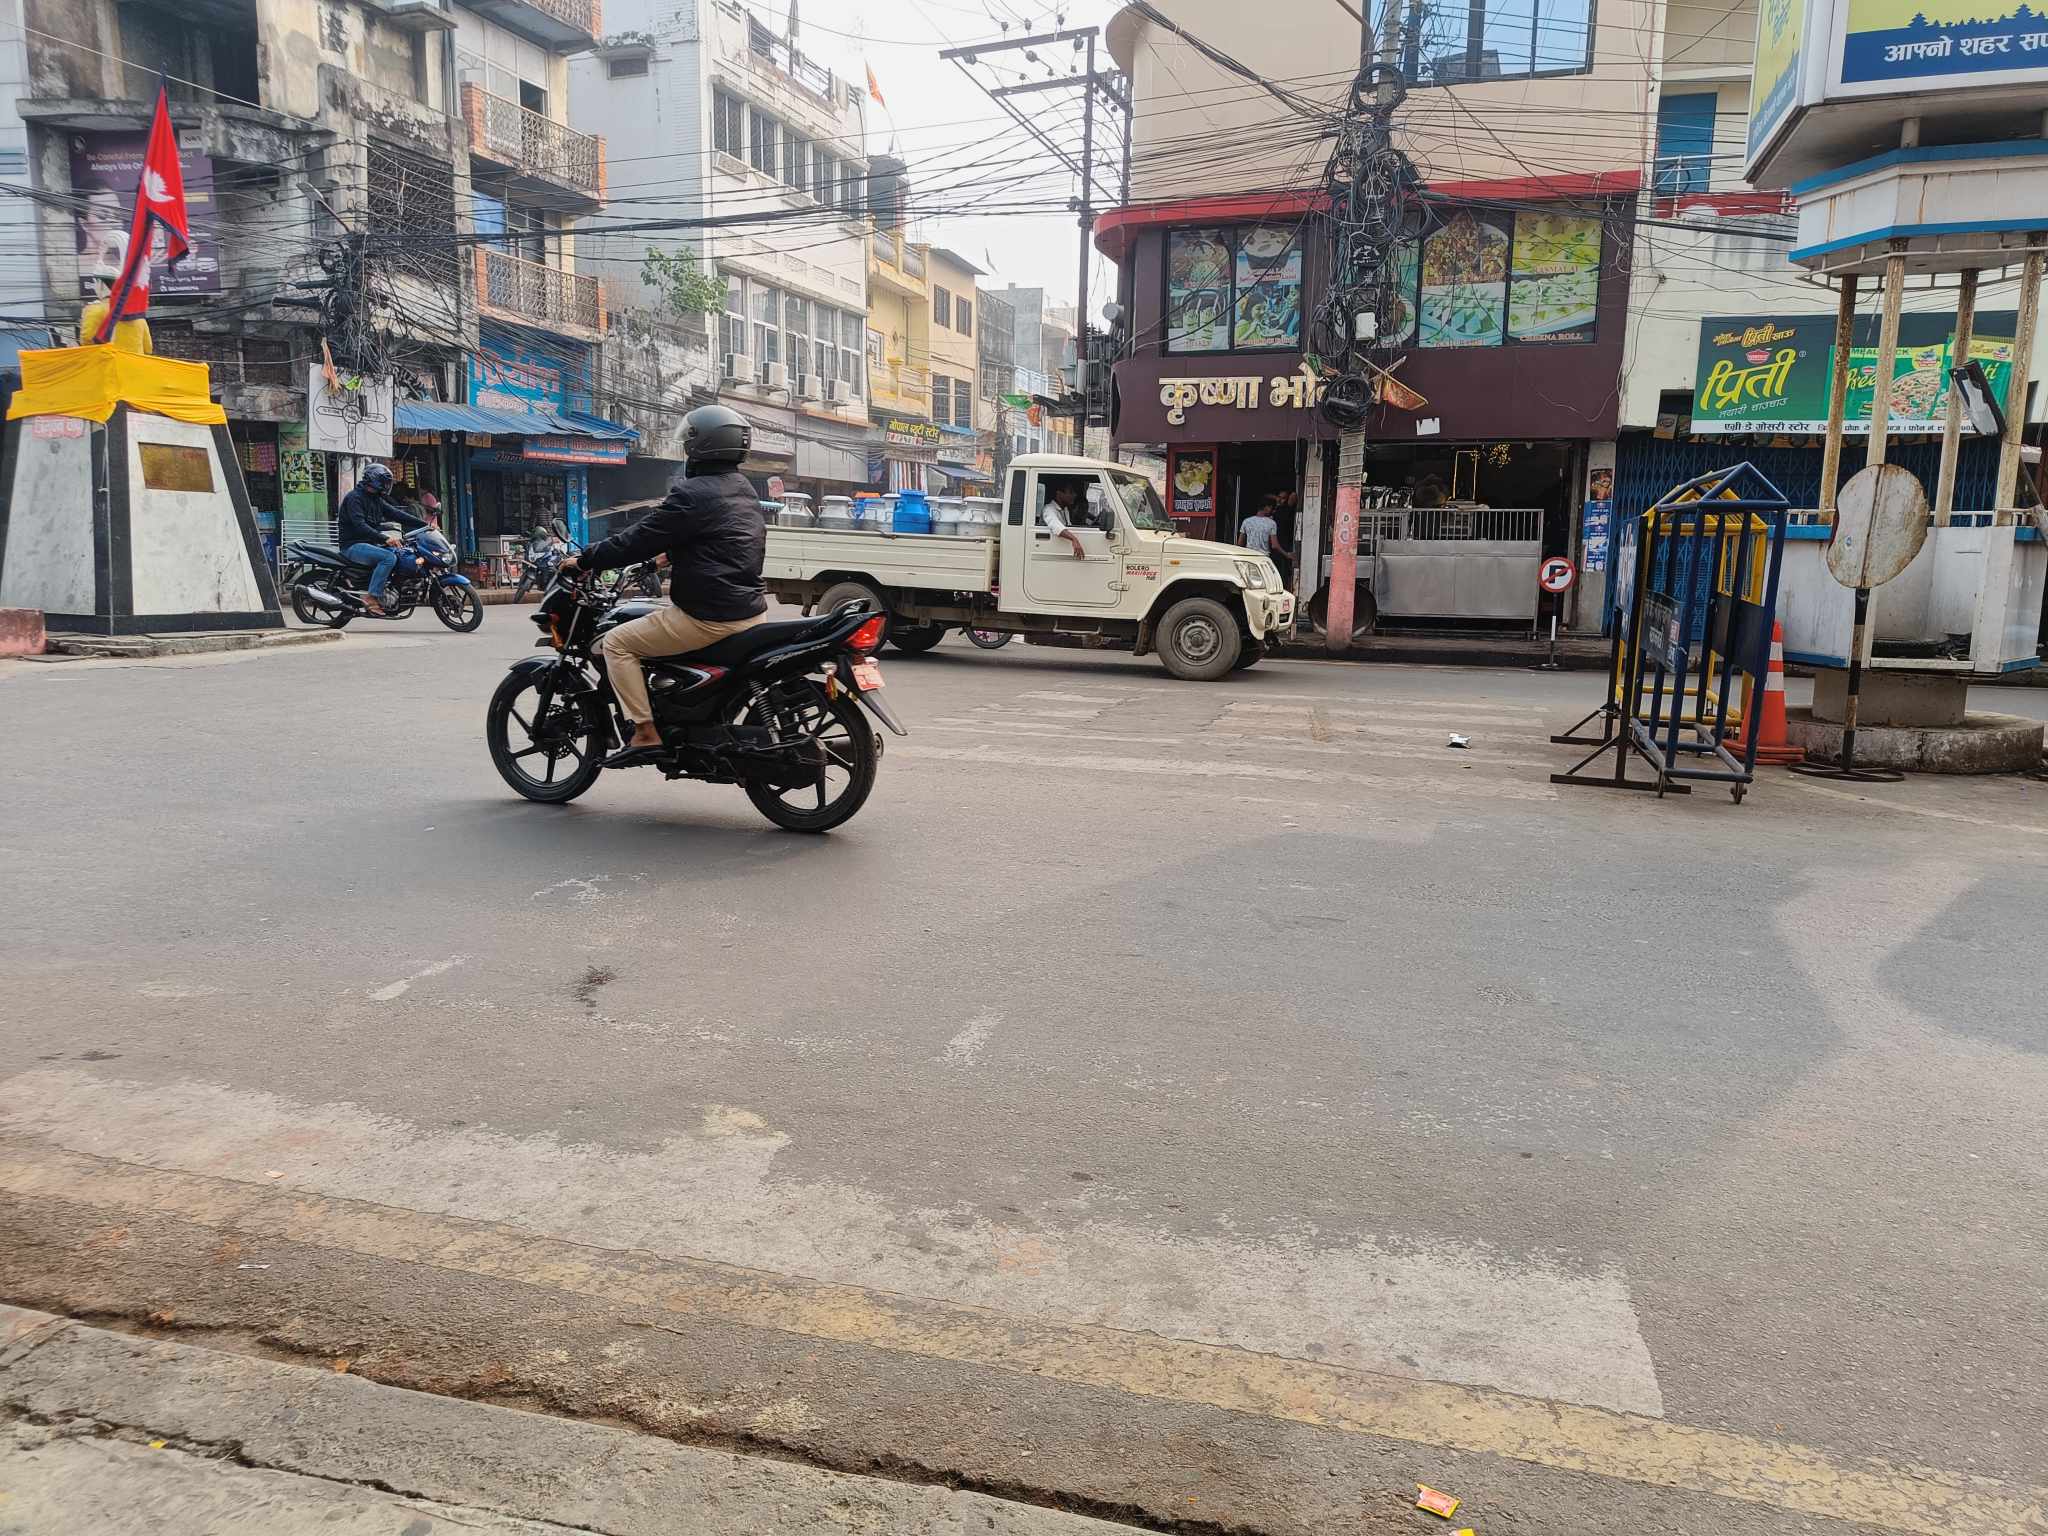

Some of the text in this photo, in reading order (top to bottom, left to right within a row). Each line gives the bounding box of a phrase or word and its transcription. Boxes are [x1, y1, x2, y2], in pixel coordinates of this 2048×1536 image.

[1884, 36, 1952, 63] आफ्नो
[1959, 35, 2013, 56] शहर
[1700, 348, 1797, 410] प्रिती
[1159, 376, 1264, 425] कृष्णा
[1548, 564, 1571, 584] P
